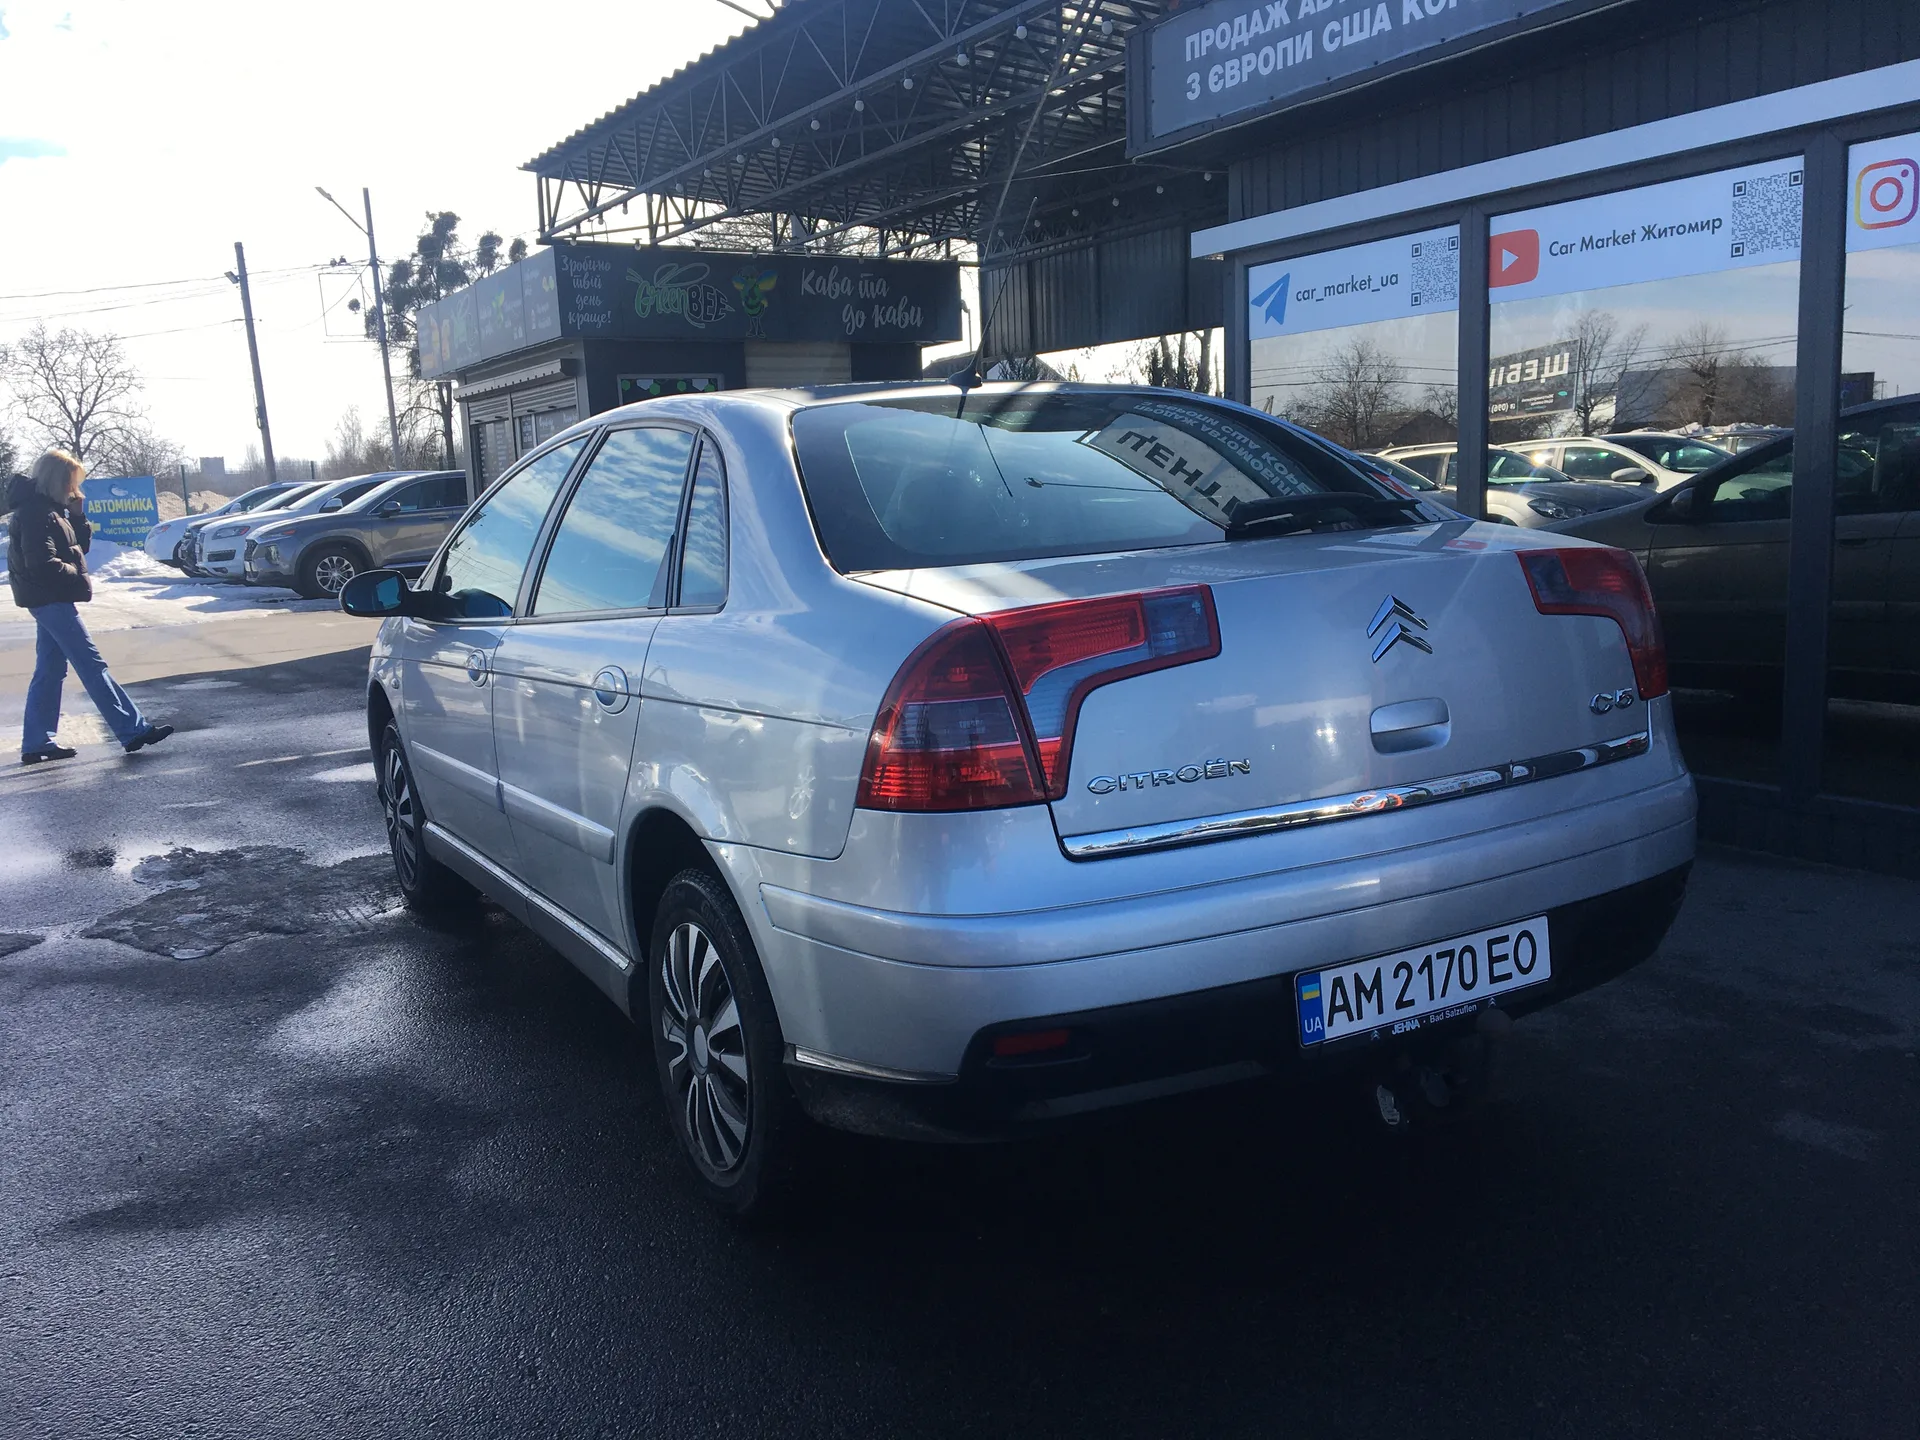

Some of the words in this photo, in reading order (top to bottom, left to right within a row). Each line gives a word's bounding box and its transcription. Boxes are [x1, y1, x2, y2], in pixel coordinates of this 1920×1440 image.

[1185, 0, 1291, 62] ПРОДАЖ
[1186, 72, 1201, 101] З
[1208, 30, 1313, 93] ЄВРОПИ
[1322, 2, 1392, 52] США
[1549, 241, 1576, 256] Car
[1580, 229, 1637, 252] Market
[1640, 217, 1723, 242] Житомир
[561, 255, 611, 277] Зробимо
[572, 274, 602, 290] твій
[801, 265, 854, 300] Кава
[858, 272, 890, 299] та
[1296, 273, 1399, 302] car_market_ua
[575, 294, 603, 311] день
[842, 303, 867, 335] до
[872, 295, 924, 329] кави
[568, 310, 612, 331] краще!
[88, 494, 154, 513] АВТОМИЙКА
[103, 527, 131, 535] ЧИСТКА
[1589, 688, 1634, 715] C5
[1087, 758, 1251, 795] CITROËN
[1327, 966, 1384, 1028] AM
[1393, 945, 1478, 1010] 2170
[1486, 929, 1538, 985] EO
[1304, 1016, 1323, 1034] UA
[1392, 1019, 1420, 1035] JEHNA
[1429, 1012, 1444, 1023] Bad
[1445, 1004, 1477, 1019] Salzuflen
